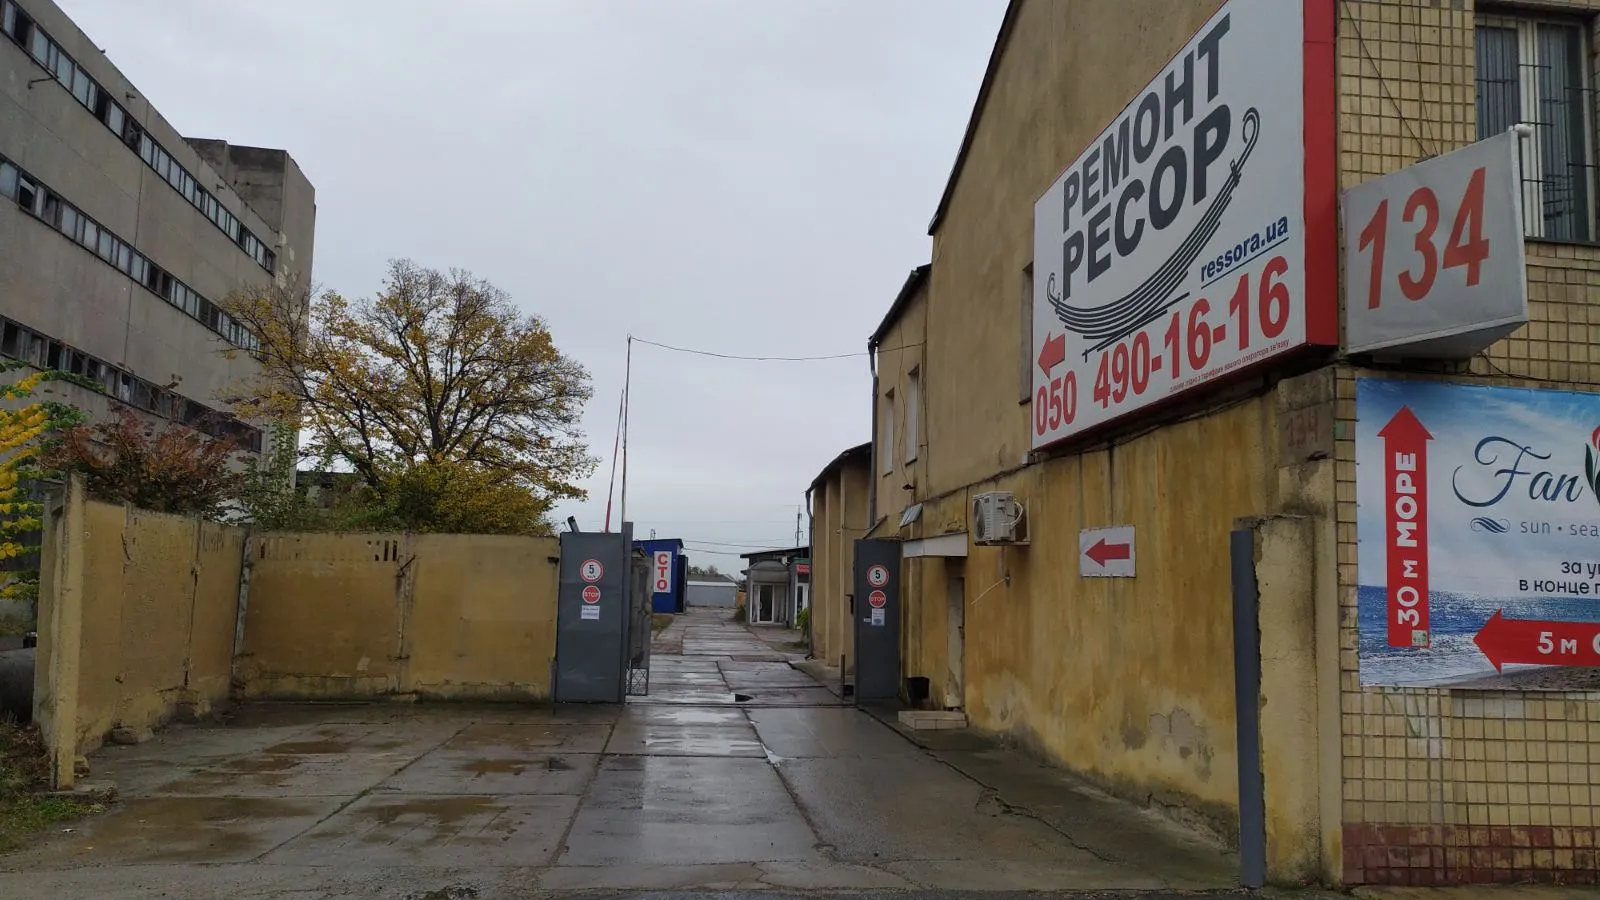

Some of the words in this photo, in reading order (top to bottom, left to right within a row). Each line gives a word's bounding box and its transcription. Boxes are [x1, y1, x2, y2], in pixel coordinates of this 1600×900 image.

[1062, 13, 1231, 234] РЕМОНТ
[1062, 103, 1231, 302] РЕСОР
[1200, 214, 1289, 282] ressora.ua
[1358, 166, 1491, 311] 134
[1036, 370, 1077, 437] 050
[1093, 255, 1290, 410] 490-16-16
[1395, 452, 1418, 548] МОРЕ
[1520, 521, 1551, 534] sun
[1570, 524, 1600, 537] sea
[588, 564, 595, 575] 5
[656, 553, 669, 591] СТО
[875, 569, 881, 580] 5
[1519, 580, 1529, 591] в
[1534, 580, 1590, 595] конце
[1561, 561, 1581, 575] за
[1396, 586, 1420, 627] 30
[1537, 631, 1554, 655] 5
[1560, 638, 1577, 655] м
